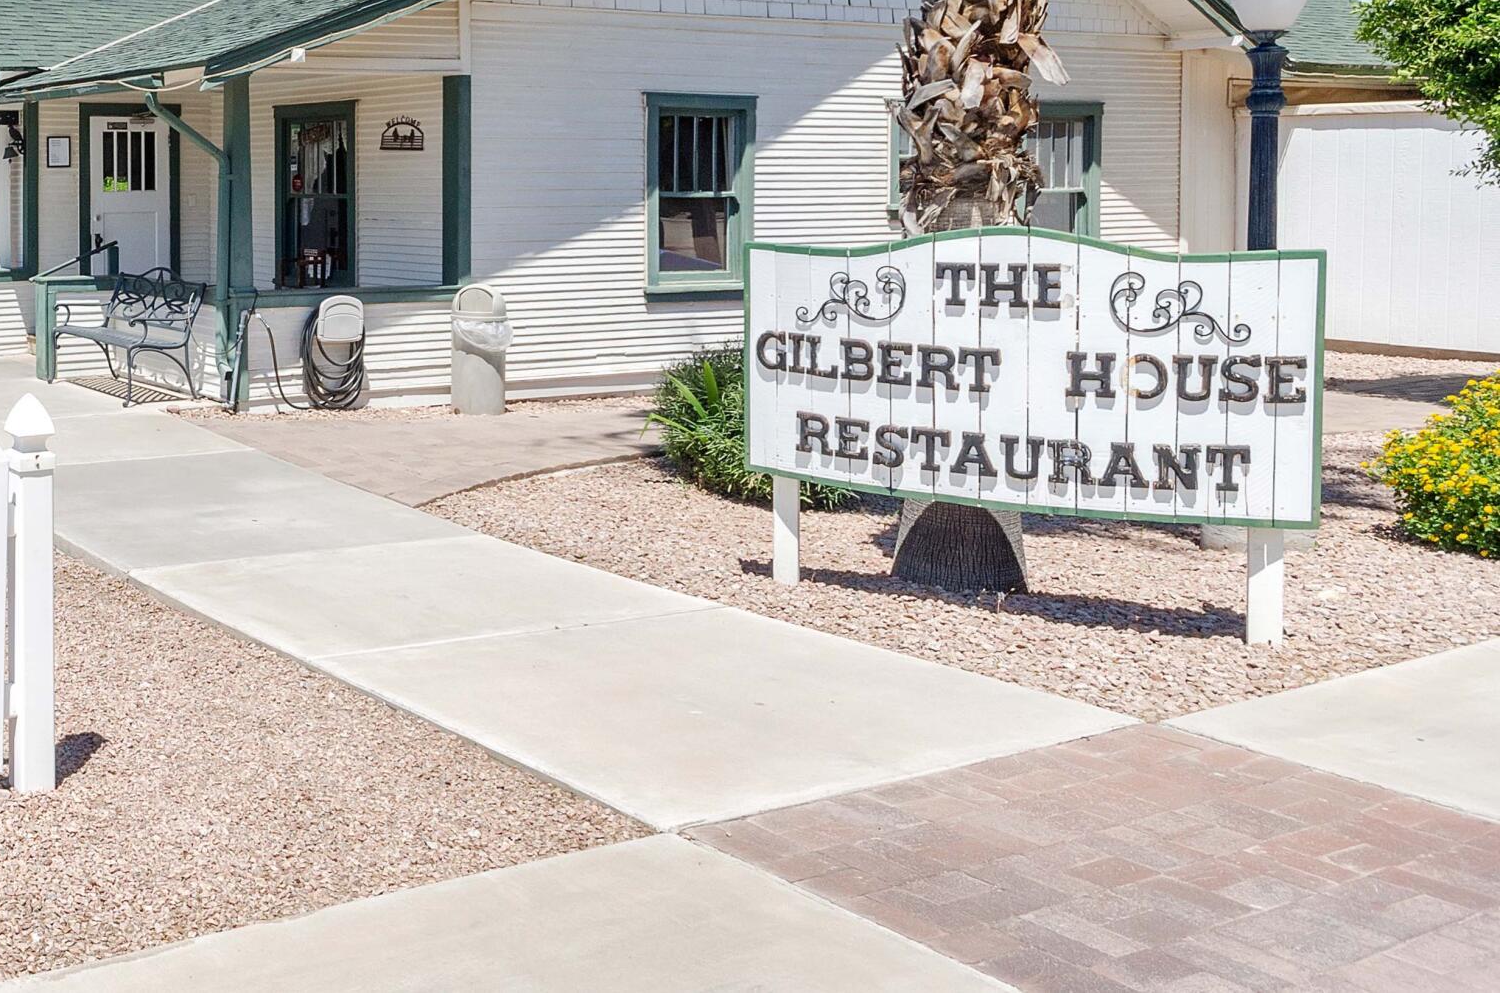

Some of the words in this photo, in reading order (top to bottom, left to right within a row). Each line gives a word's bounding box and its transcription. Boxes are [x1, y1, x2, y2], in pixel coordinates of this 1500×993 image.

[385, 115, 421, 127] WELCOME
[935, 261, 1068, 308] THE
[755, 330, 1001, 393] GILBERT
[1065, 351, 1307, 404] HOUSE
[795, 410, 1251, 492] RESTAURANT
